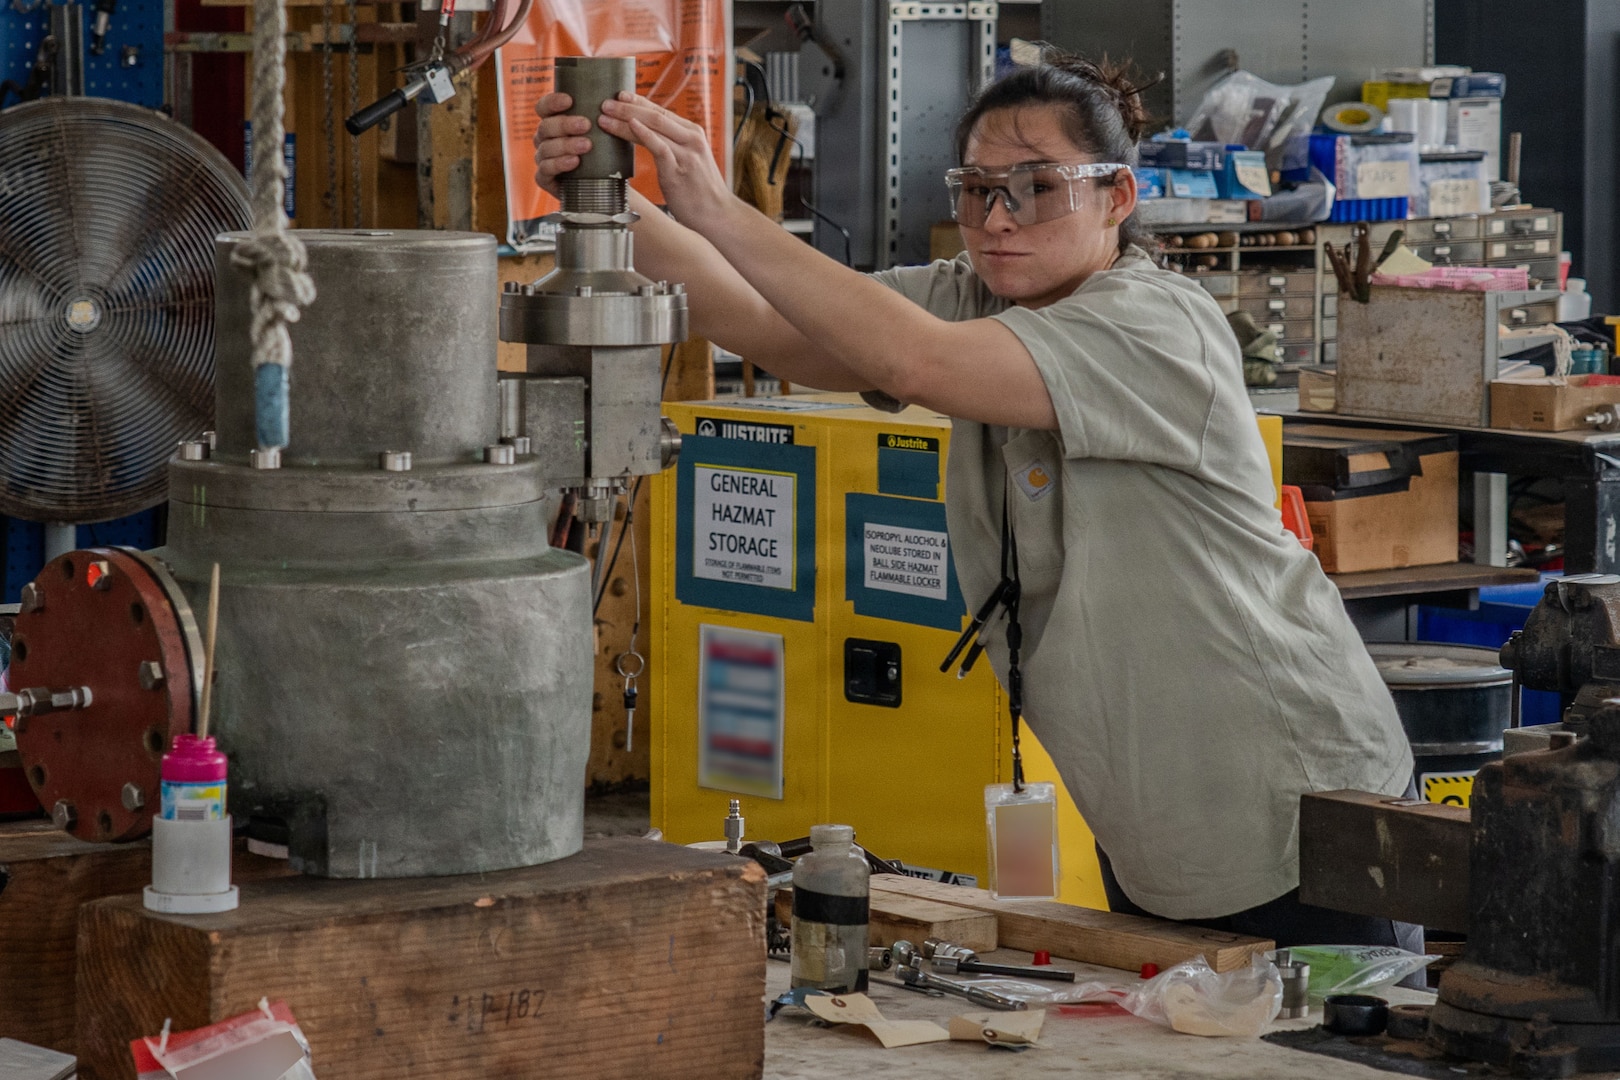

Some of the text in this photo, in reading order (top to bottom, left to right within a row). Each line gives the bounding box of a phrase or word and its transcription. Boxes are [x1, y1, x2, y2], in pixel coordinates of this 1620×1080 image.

[896, 436, 929, 450] Justrite
[710, 473, 778, 498] GENERAL
[712, 503, 776, 528] HAZMAT
[709, 532, 778, 558] STORAGE
[904, 535, 939, 547] ALOCHOL
[941, 538, 946, 548] &
[870, 544, 941, 560] NEOLUBE STORED IN
[705, 558, 728, 569] STORAGE
[728, 560, 735, 569] OF
[872, 557, 938, 574] BALL SIDE HAZMAT
[722, 570, 733, 578] NOT
[870, 570, 941, 588] FLAMMABLE LOCKER
